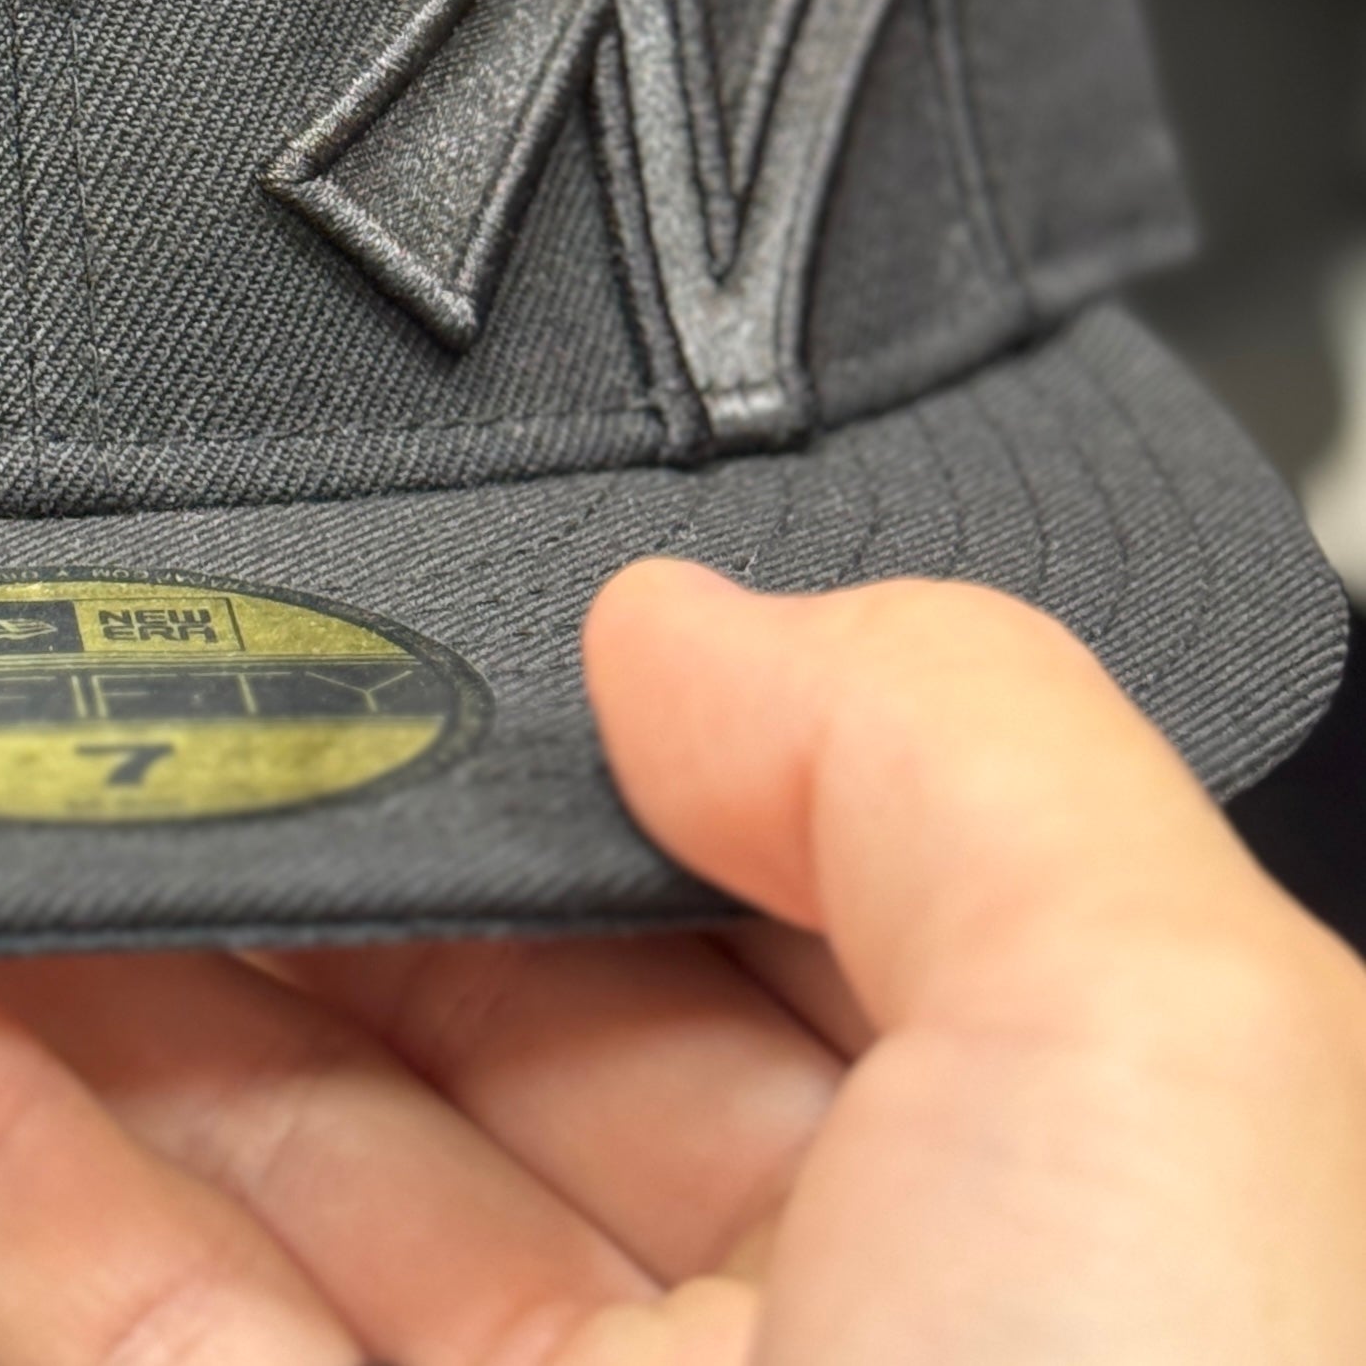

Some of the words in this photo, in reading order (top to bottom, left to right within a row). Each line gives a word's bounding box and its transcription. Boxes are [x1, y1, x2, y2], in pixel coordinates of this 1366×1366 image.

[99, 609, 211, 625] NEW
[102, 626, 218, 643] ERA
[74, 743, 175, 787] 7
